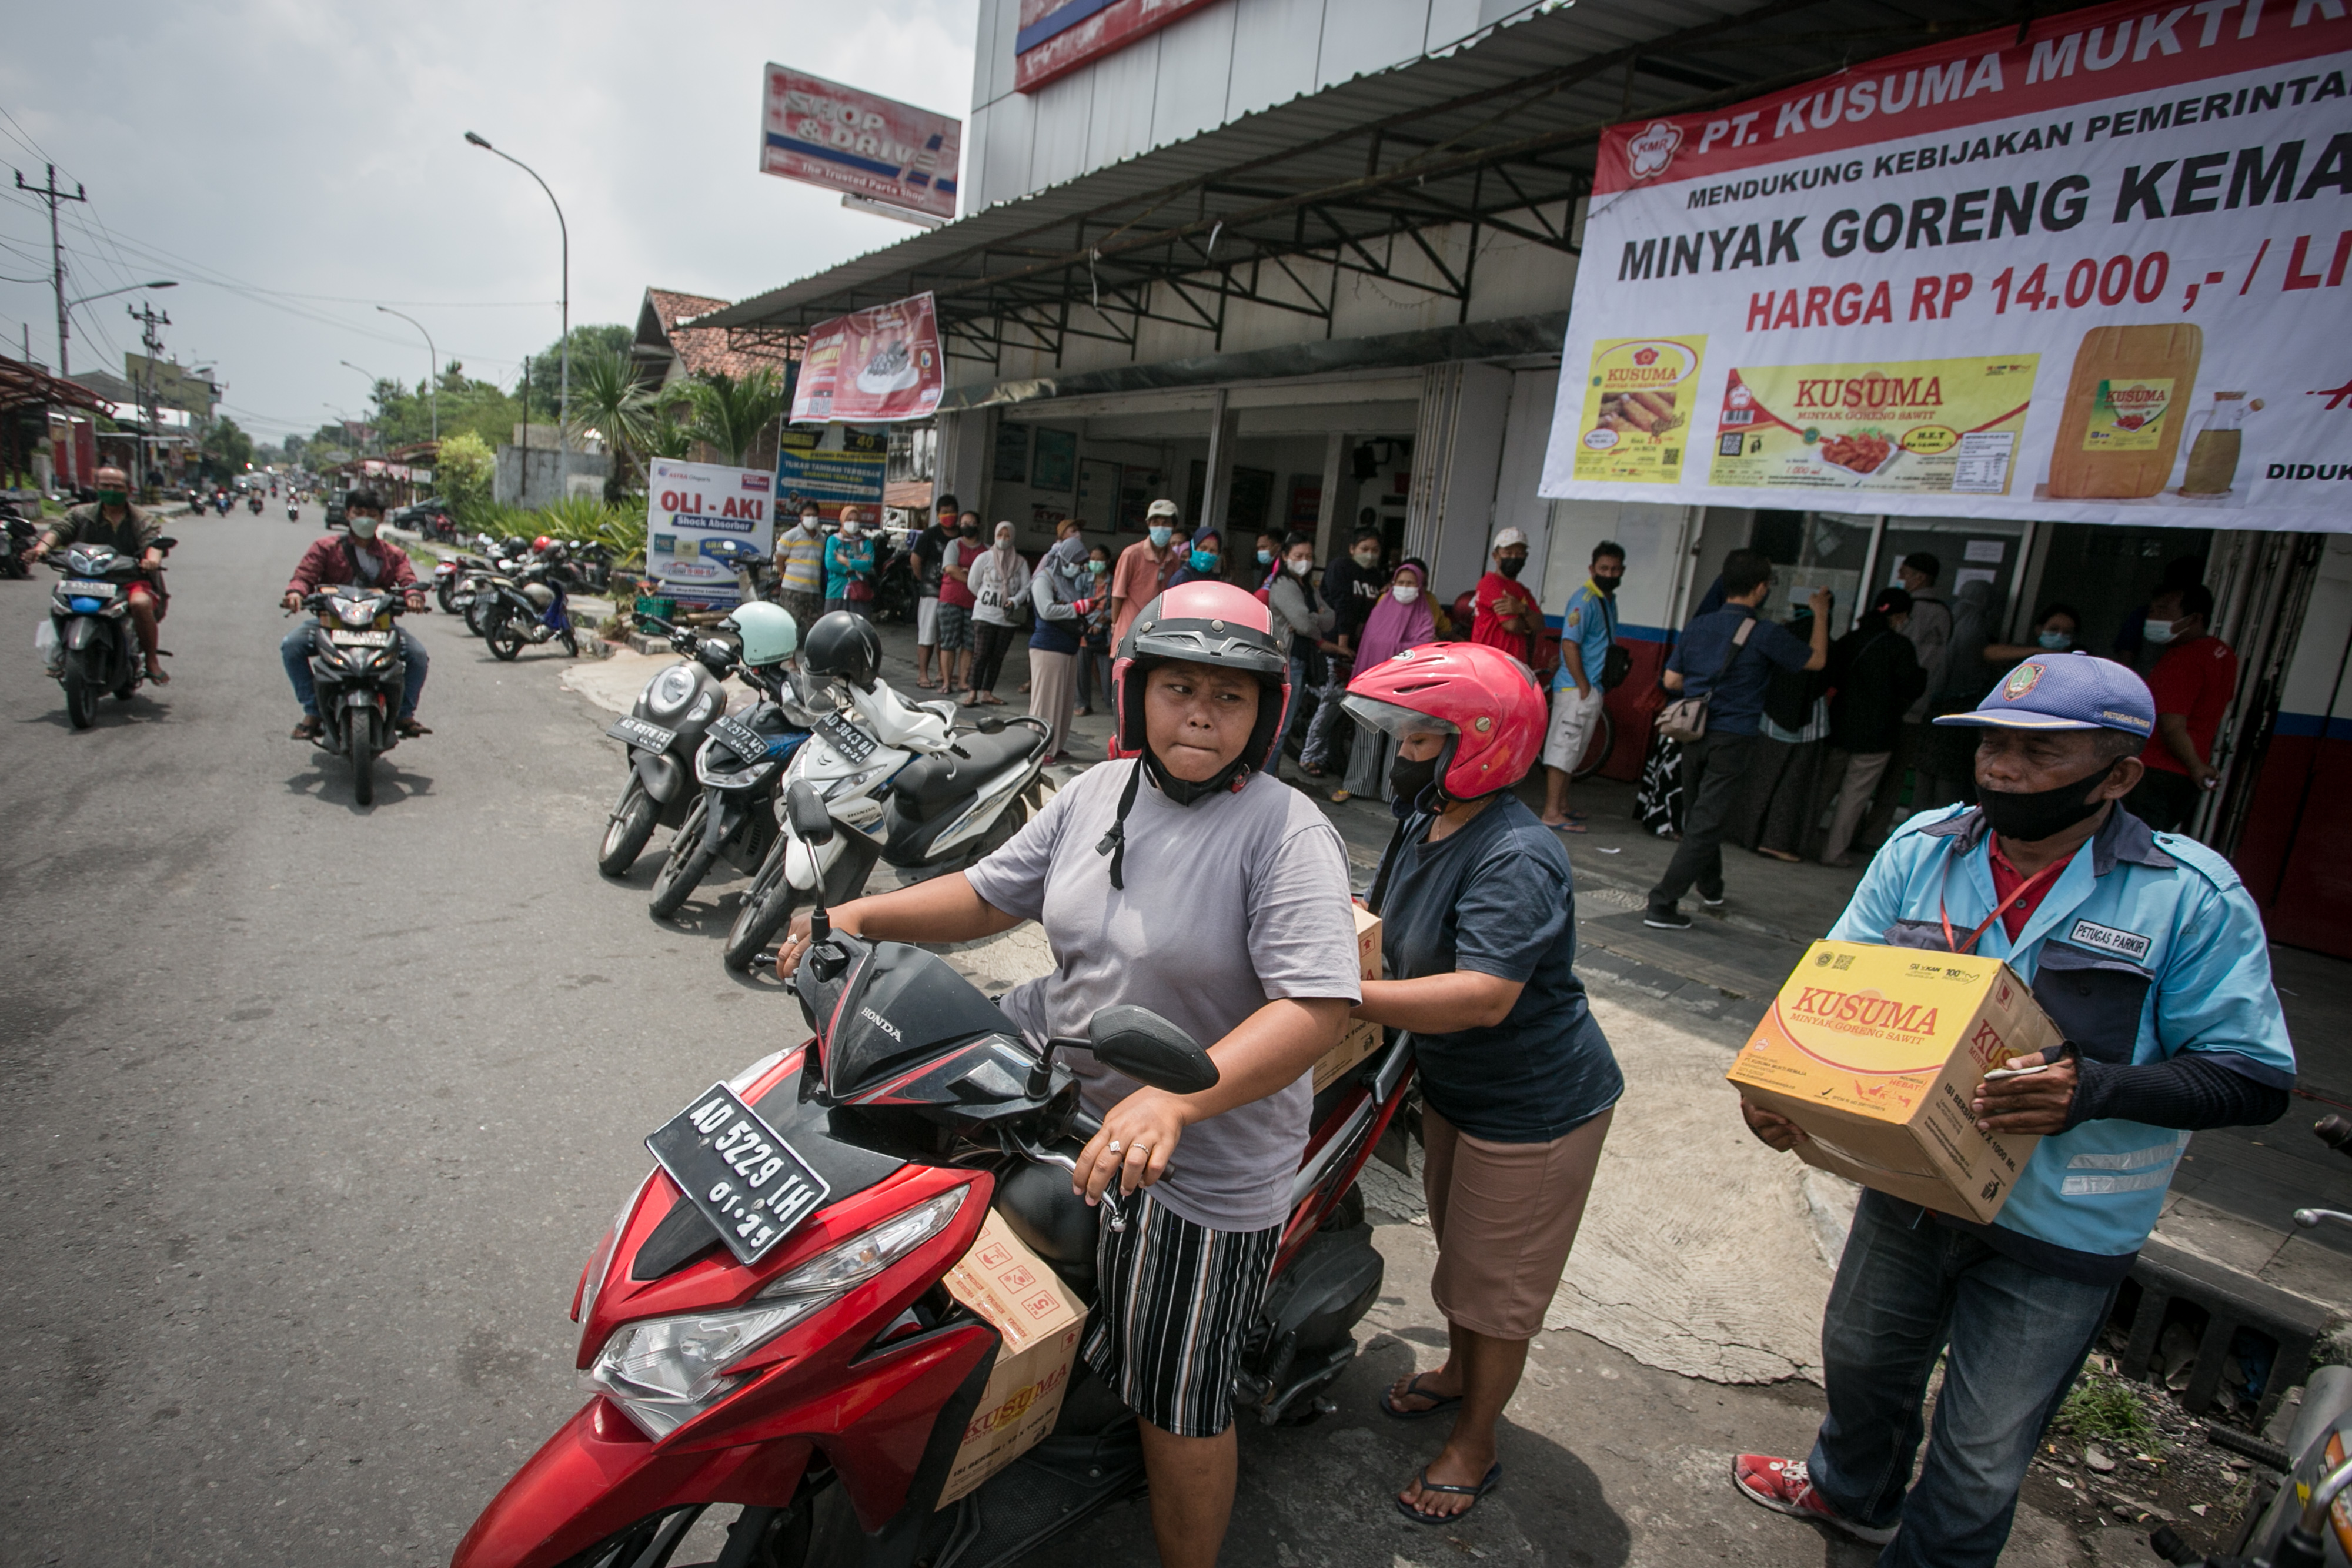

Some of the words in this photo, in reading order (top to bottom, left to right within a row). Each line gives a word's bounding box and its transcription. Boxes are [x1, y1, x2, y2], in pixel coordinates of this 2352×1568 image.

[1698, 110, 1759, 155] PT.
[1773, 52, 2004, 140] KUSUMA
[2025, 0, 2264, 85] MUKTI
[784, 90, 884, 131] SHOP
[797, 118, 821, 142] &
[828, 128, 938, 173] DRIVE
[1638, 138, 1669, 153] KMR
[1686, 159, 1864, 209] MENDUKUNG
[1873, 121, 2074, 178] KEBIJAKAN
[2084, 70, 2352, 143] PEMERINTA
[802, 162, 823, 176] The
[825, 170, 867, 189] Trusted
[868, 179, 899, 196] Parts
[900, 188, 926, 203] Shop
[1617, 215, 1808, 282] MINYAK
[1822, 174, 2090, 258] GORENG
[1746, 280, 1893, 332] HARGA
[1909, 272, 1973, 322] RP
[1990, 251, 2170, 315] 14.000
[2237, 238, 2271, 296] /
[1606, 367, 1678, 382] KUSUMA
[1793, 376, 1943, 408] KUSUMA
[2104, 390, 2165, 403] KUSUMA
[1797, 412, 1842, 420] MINYAK
[1845, 411, 1895, 421] GORENG
[1897, 411, 1936, 420] SAWIT
[857, 434, 875, 449] 40
[785, 460, 810, 470] TUKAR
[811, 462, 843, 473] TAMBAH
[843, 465, 881, 478] TERBESAR
[661, 490, 703, 514] OLI
[721, 496, 764, 521] AKI
[677, 516, 706, 527] Shock
[708, 520, 750, 531] Absorber
[822, 711, 840, 727] AD
[836, 722, 862, 745] 3843
[2103, 710, 2133, 723] PETUGAS
[620, 718, 636, 730] AD
[656, 731, 670, 743] YS
[715, 716, 730, 728] AD
[727, 723, 752, 741] 2577
[748, 738, 765, 754] WS
[847, 805, 876, 818] HONDA
[2076, 925, 2112, 945] PETUGAS
[2112, 935, 2145, 954] PARKIR
[1791, 986, 1939, 1037] KUSUMA
[861, 1006, 901, 1043] HONDA
[1789, 1013, 1835, 1029] MINYAK
[1834, 1022, 1885, 1039] GORENG
[1885, 1032, 1925, 1045] SAWIT
[1944, 1082, 1956, 1098] ISI
[1953, 1094, 1976, 1125] BERSIH
[1984, 1134, 1993, 1145] X
[1991, 1140, 2008, 1162] 1000
[2005, 1157, 2017, 1173] ML
[689, 1096, 735, 1135] AD
[714, 1119, 784, 1188] 5229
[766, 1174, 816, 1222] IH
[956, 1280, 975, 1299] KUSUMA
[965, 1272, 985, 1291] KUSUMA
[976, 1302, 997, 1323] KUSUMA
[986, 1293, 1006, 1315] KUSUMA
[1027, 1303, 1040, 1316] MAX
[1033, 1298, 1050, 1311] 5
[1007, 1317, 1028, 1339] KUSUMA
[963, 1362, 1067, 1442] KUSUMA
[963, 1423, 1000, 1447] MINYAK
[953, 1466, 966, 1477] ISI
